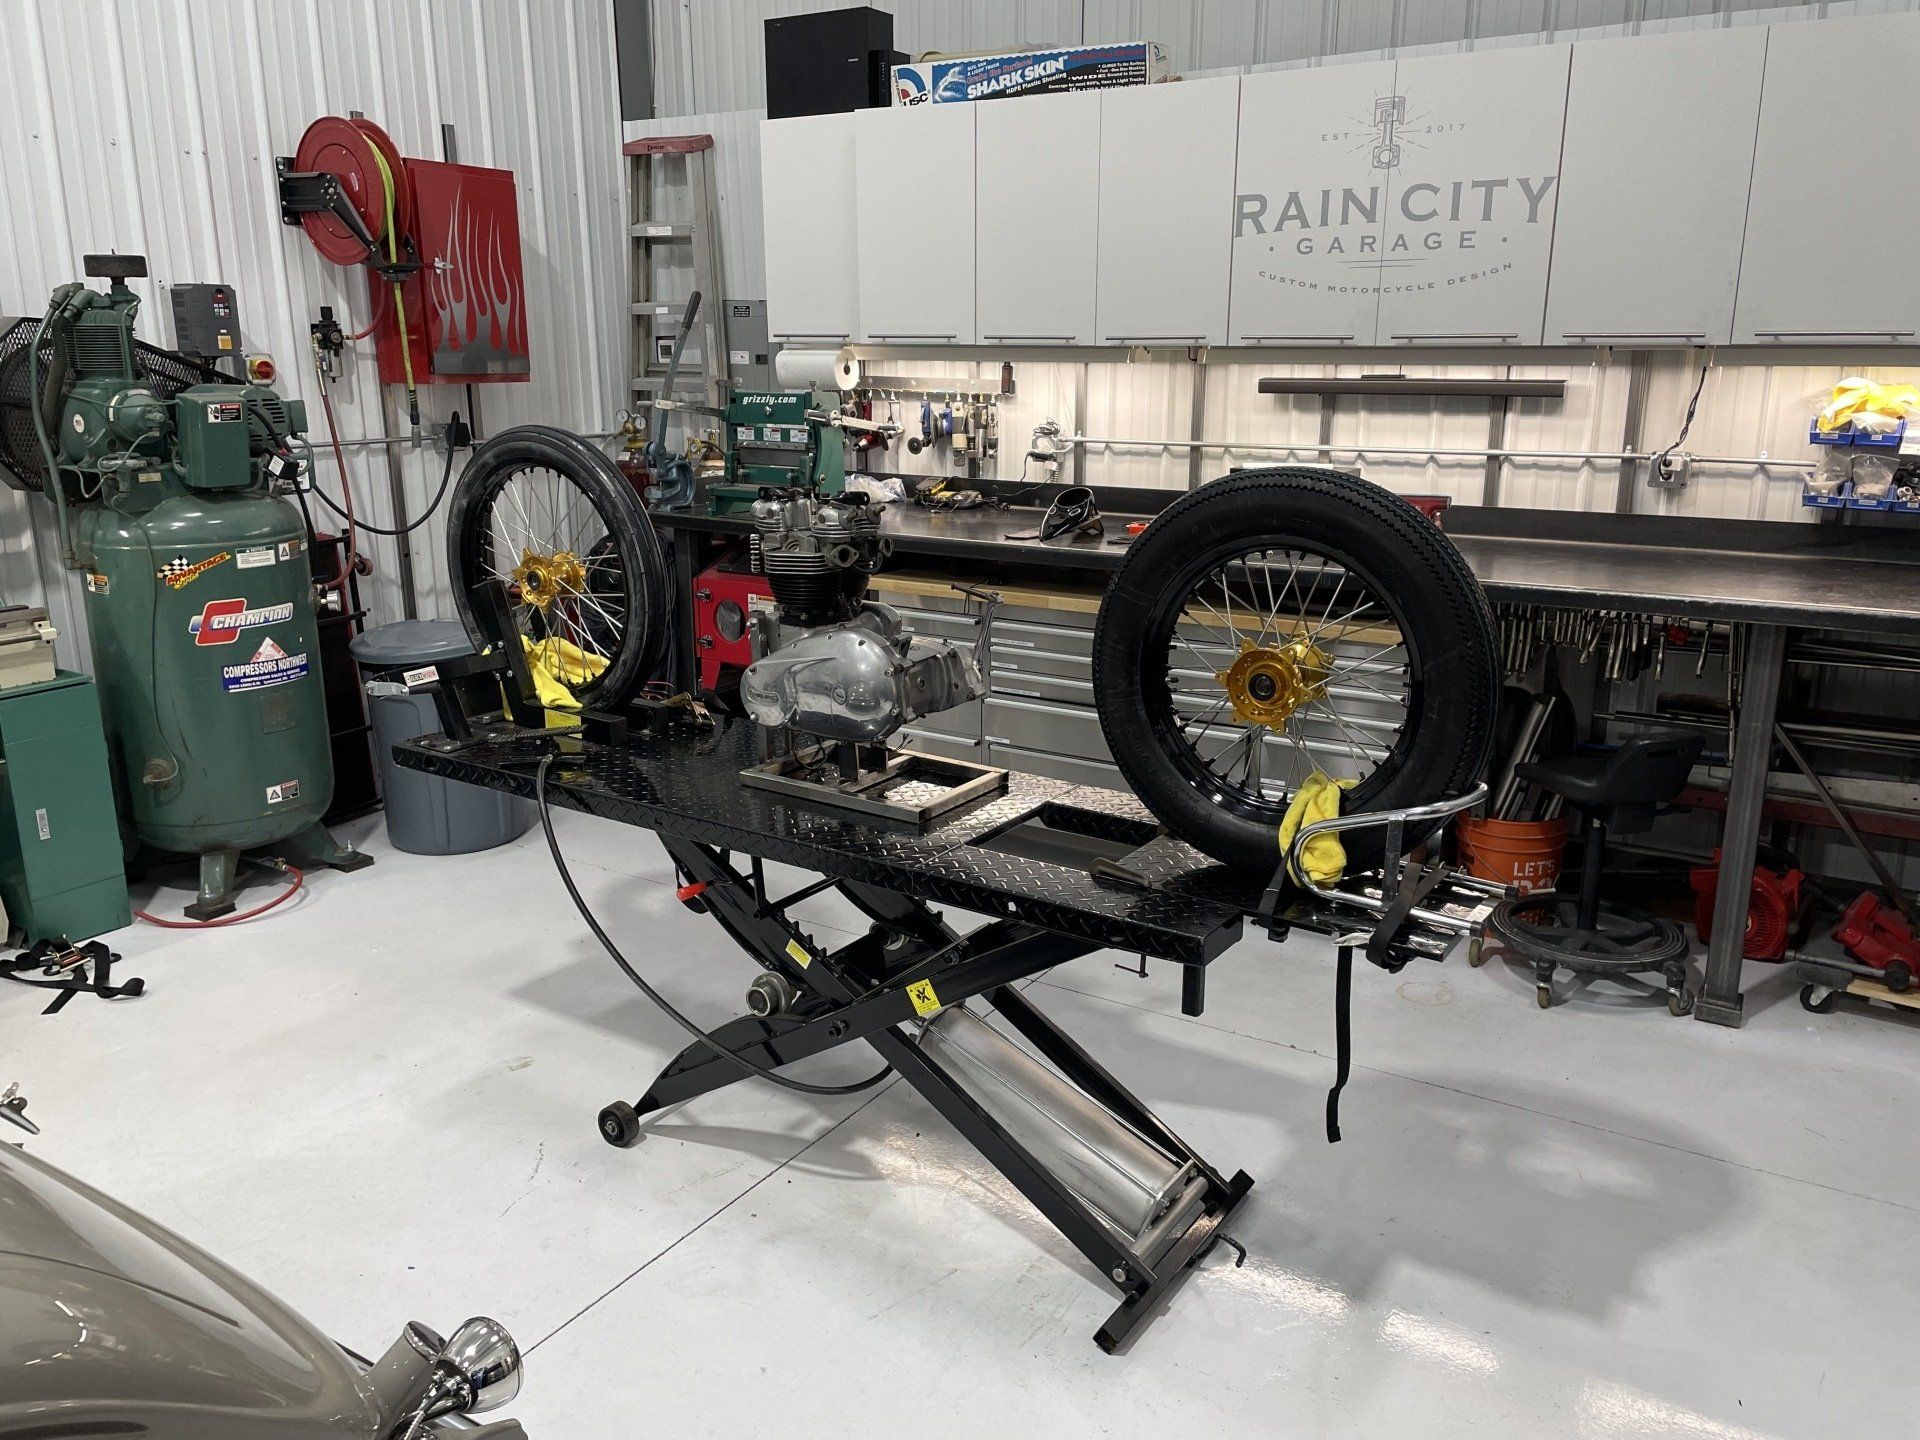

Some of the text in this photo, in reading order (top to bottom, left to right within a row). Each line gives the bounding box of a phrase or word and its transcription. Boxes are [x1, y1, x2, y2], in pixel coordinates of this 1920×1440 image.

[967, 56, 1065, 99] SHARK SKIN
[1006, 72, 1067, 94] HDPE Plastic Sheeting
[1321, 123, 1466, 142] EST 2017
[1234, 176, 1557, 238] RAIN CITY
[1296, 230, 1477, 255] GARAGE
[1259, 262, 1513, 294] CUSTOM MOTORCYCLE DESIGN
[742, 394, 797, 405] grizzly.com
[167, 553, 228, 585] ADVANTAGE
[212, 605, 291, 630] CHAMPION
[223, 653, 308, 679] COMPRESSORS NORTHWEST
[1513, 860, 1556, 877] LET'S
